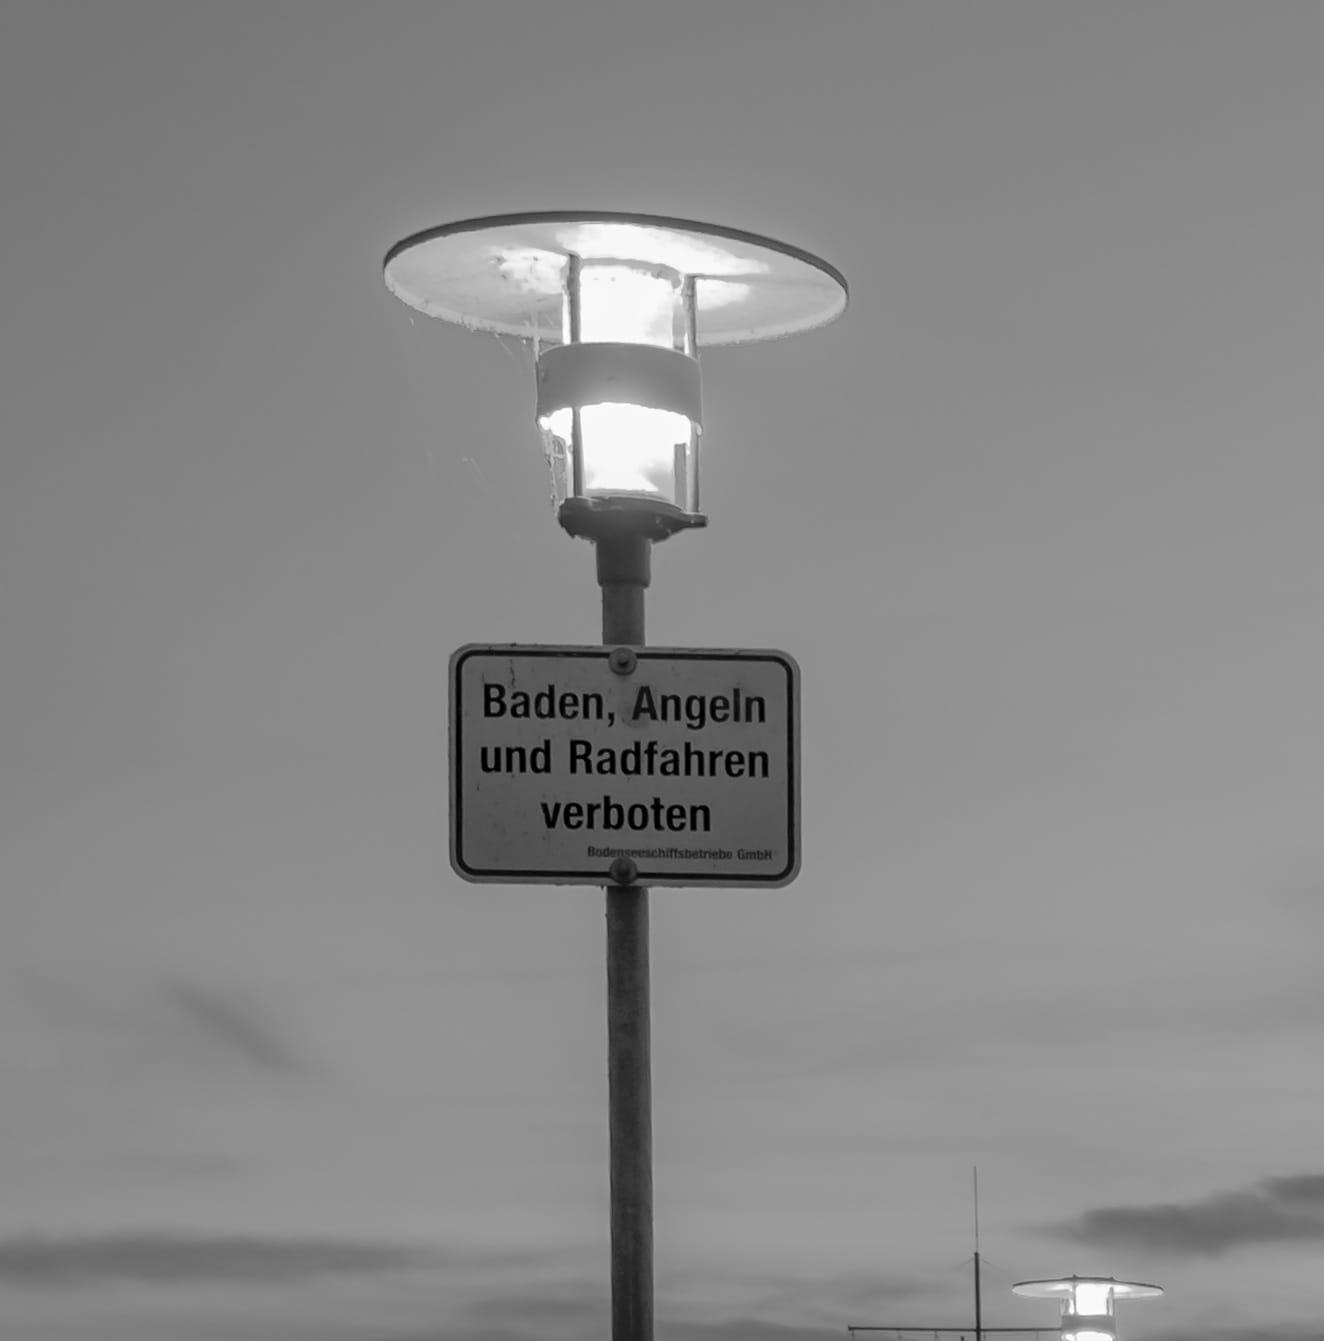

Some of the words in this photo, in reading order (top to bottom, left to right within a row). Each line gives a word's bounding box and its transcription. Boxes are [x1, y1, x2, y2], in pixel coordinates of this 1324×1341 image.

[482, 683, 615, 726] Baden,
[631, 685, 766, 730] Angeln
[479, 739, 551, 774] und
[568, 739, 769, 777] Radfahren
[540, 795, 711, 832] verboten
[587, 845, 733, 860] Bodenseeschiffsbetriebe
[736, 848, 773, 861] GmbH
